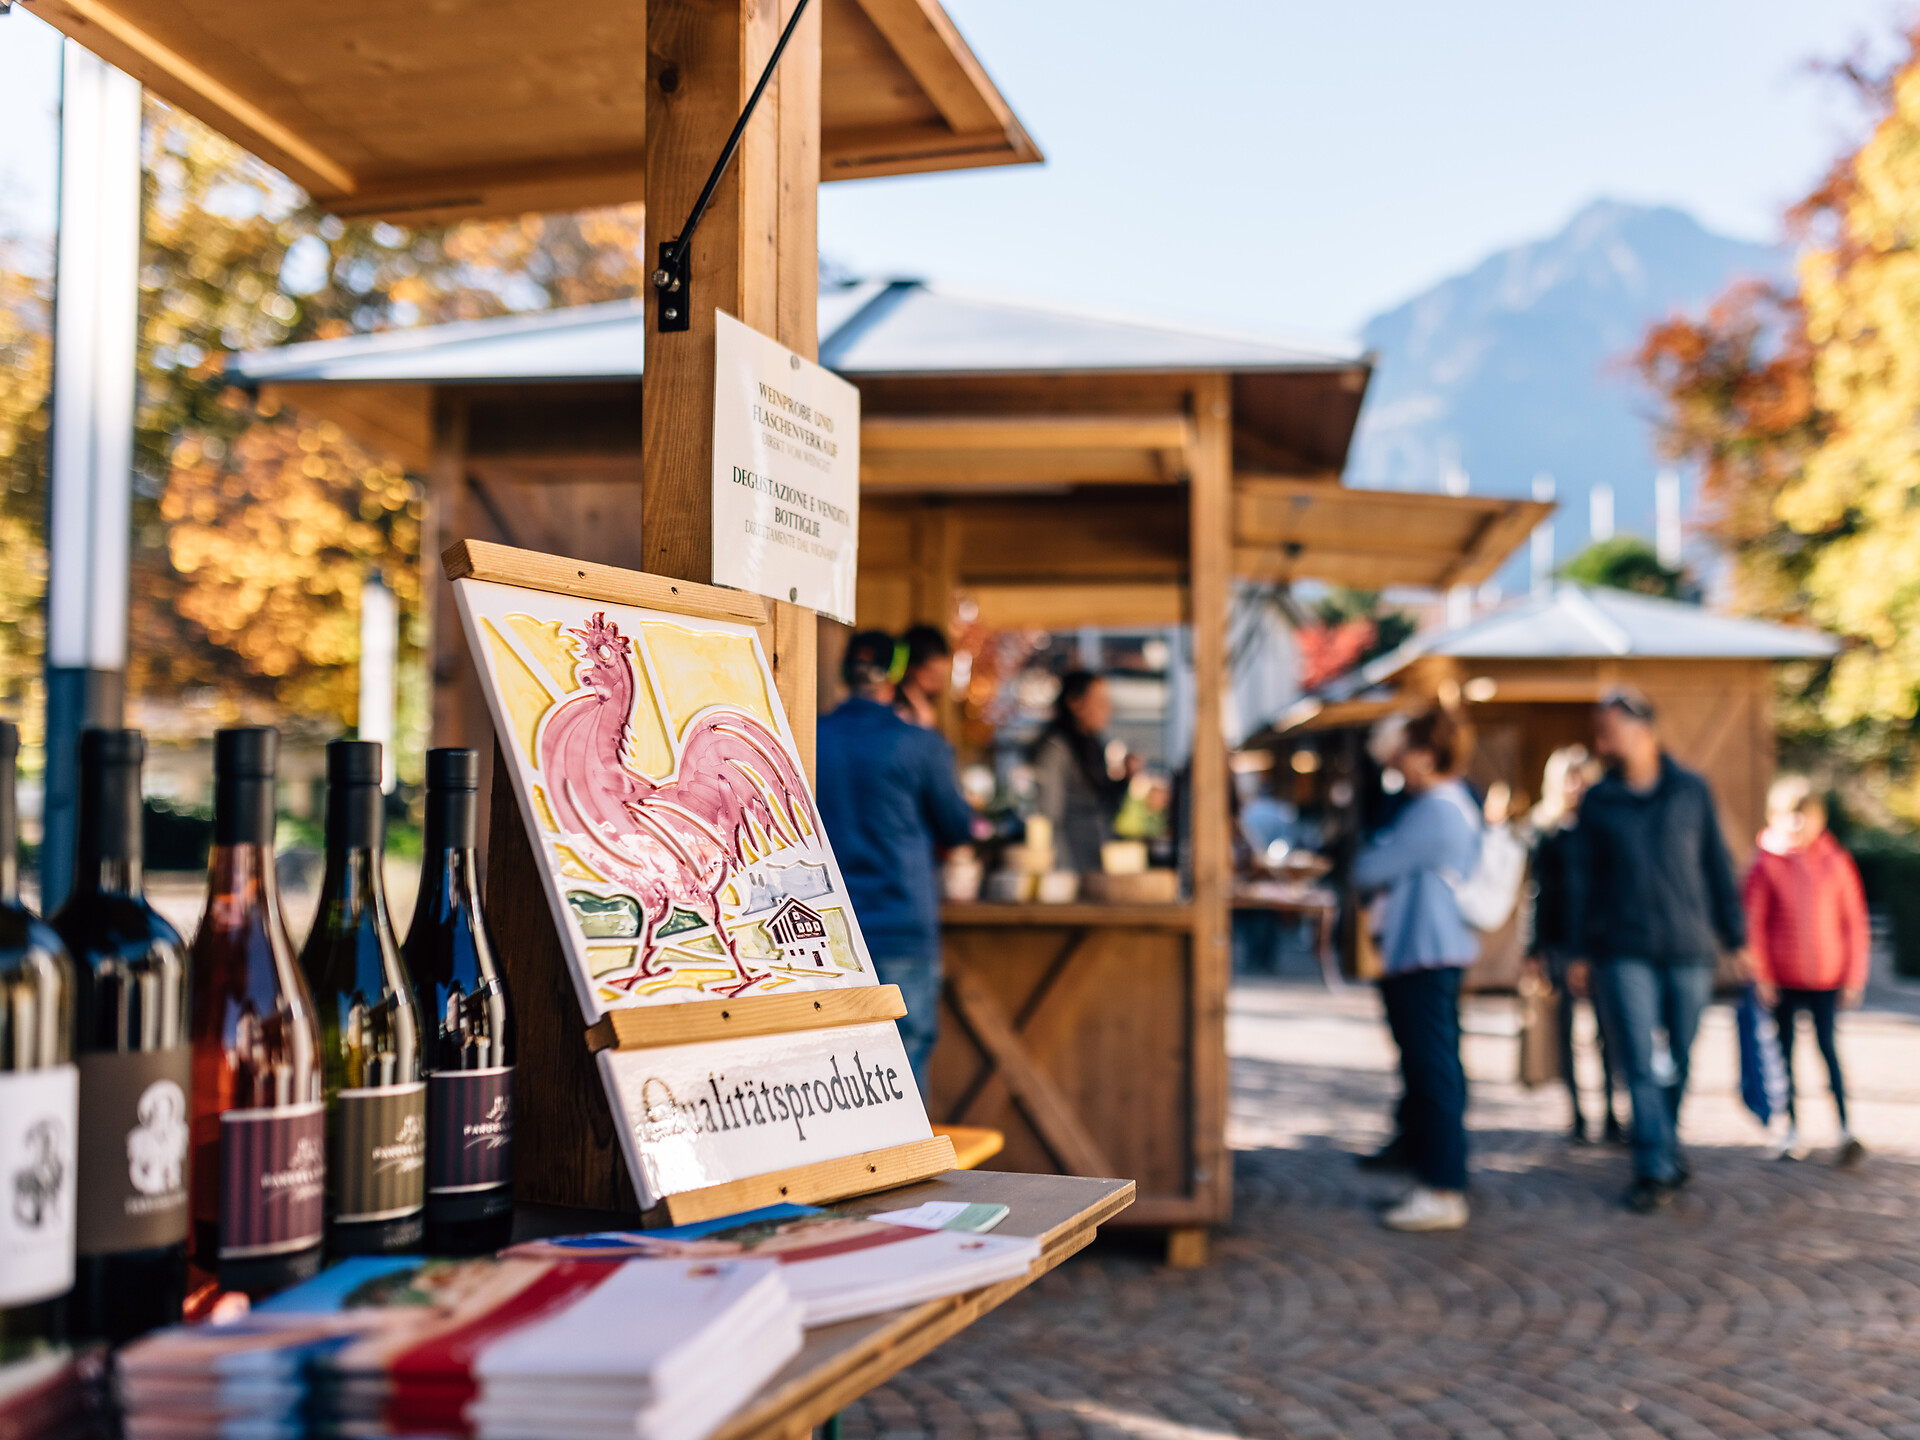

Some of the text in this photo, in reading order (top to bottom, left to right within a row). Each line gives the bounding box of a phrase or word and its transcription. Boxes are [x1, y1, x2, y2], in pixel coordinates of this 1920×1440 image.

[758, 381, 835, 434] WEINPROBE UND
[732, 465, 850, 528] DEGUSTAZIONE E VENDITA
[774, 506, 820, 538] BOTTIGLIE
[745, 519, 796, 549] DIRETTAMENTE
[642, 1050, 904, 1142] Qualitätsprodukte
